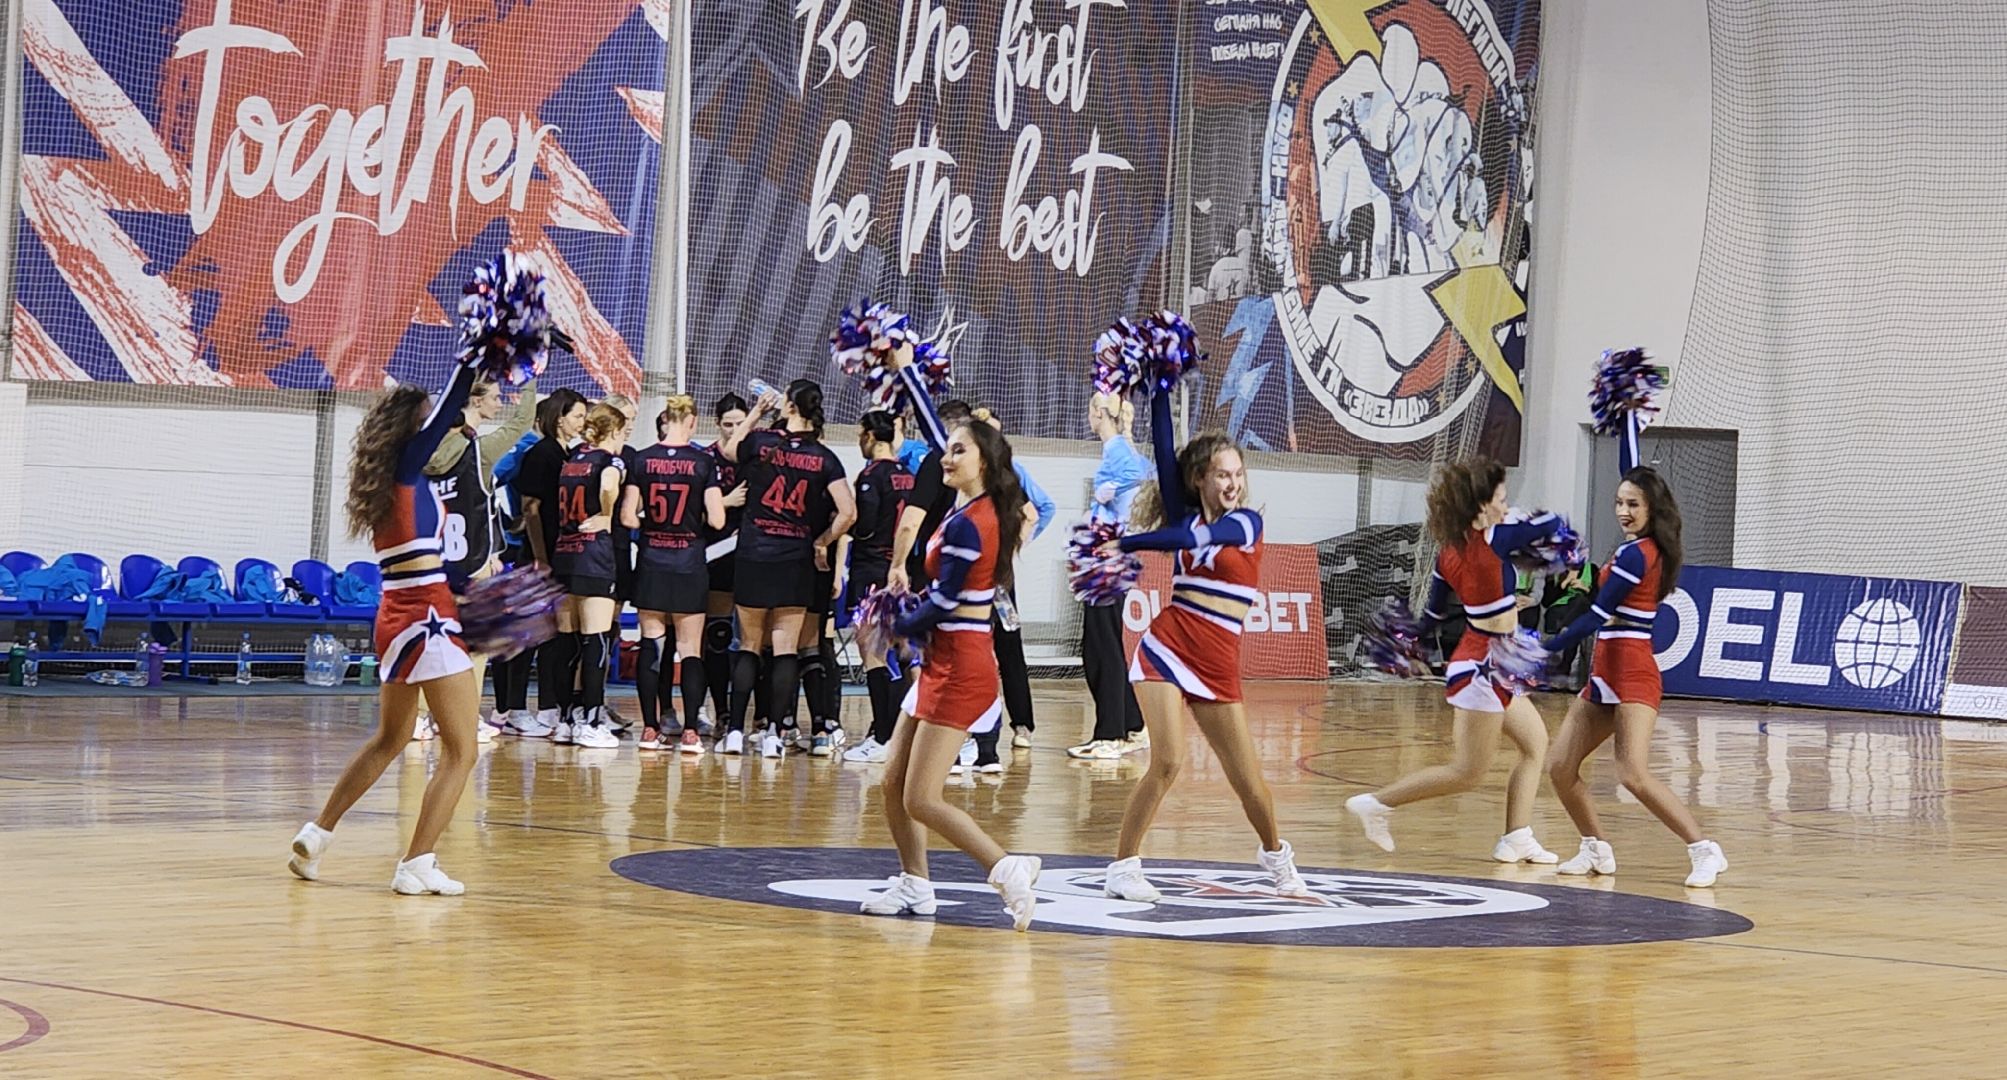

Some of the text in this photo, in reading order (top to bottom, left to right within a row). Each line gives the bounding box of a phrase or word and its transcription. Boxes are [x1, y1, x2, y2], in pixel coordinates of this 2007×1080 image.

[796, 0, 877, 98] Be
[995, 0, 1129, 131] first
[174, 0, 562, 303] Together
[807, 119, 1135, 278] be the best
[649, 483, 690, 525] 57
[761, 475, 808, 517] 44
